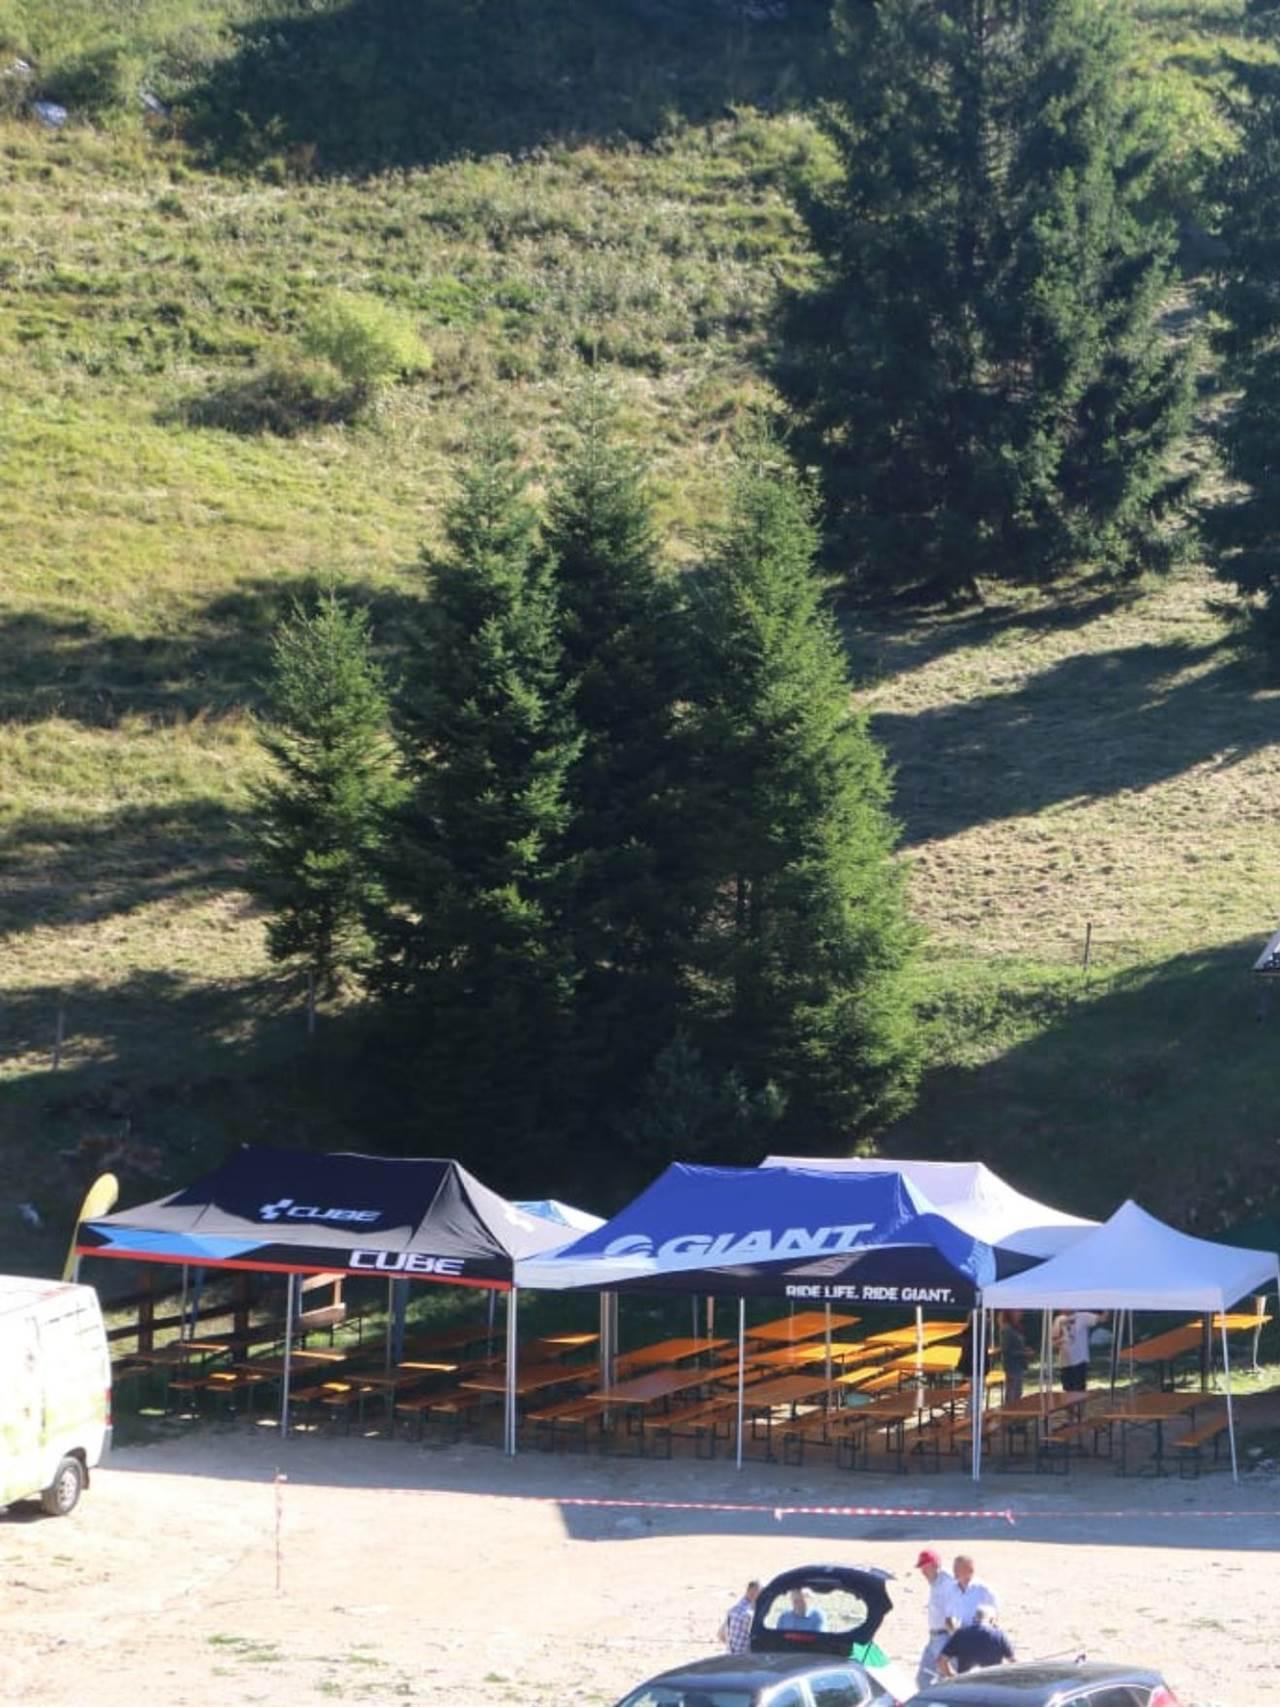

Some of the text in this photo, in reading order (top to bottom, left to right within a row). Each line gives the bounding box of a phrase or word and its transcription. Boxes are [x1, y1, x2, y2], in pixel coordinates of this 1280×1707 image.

[288, 1205, 381, 1221] CUBE
[657, 1223, 875, 1259] GIANT
[349, 1250, 465, 1276] CUBE
[785, 1285, 956, 1303] RIDE LIFE. RIDE GIANT.
